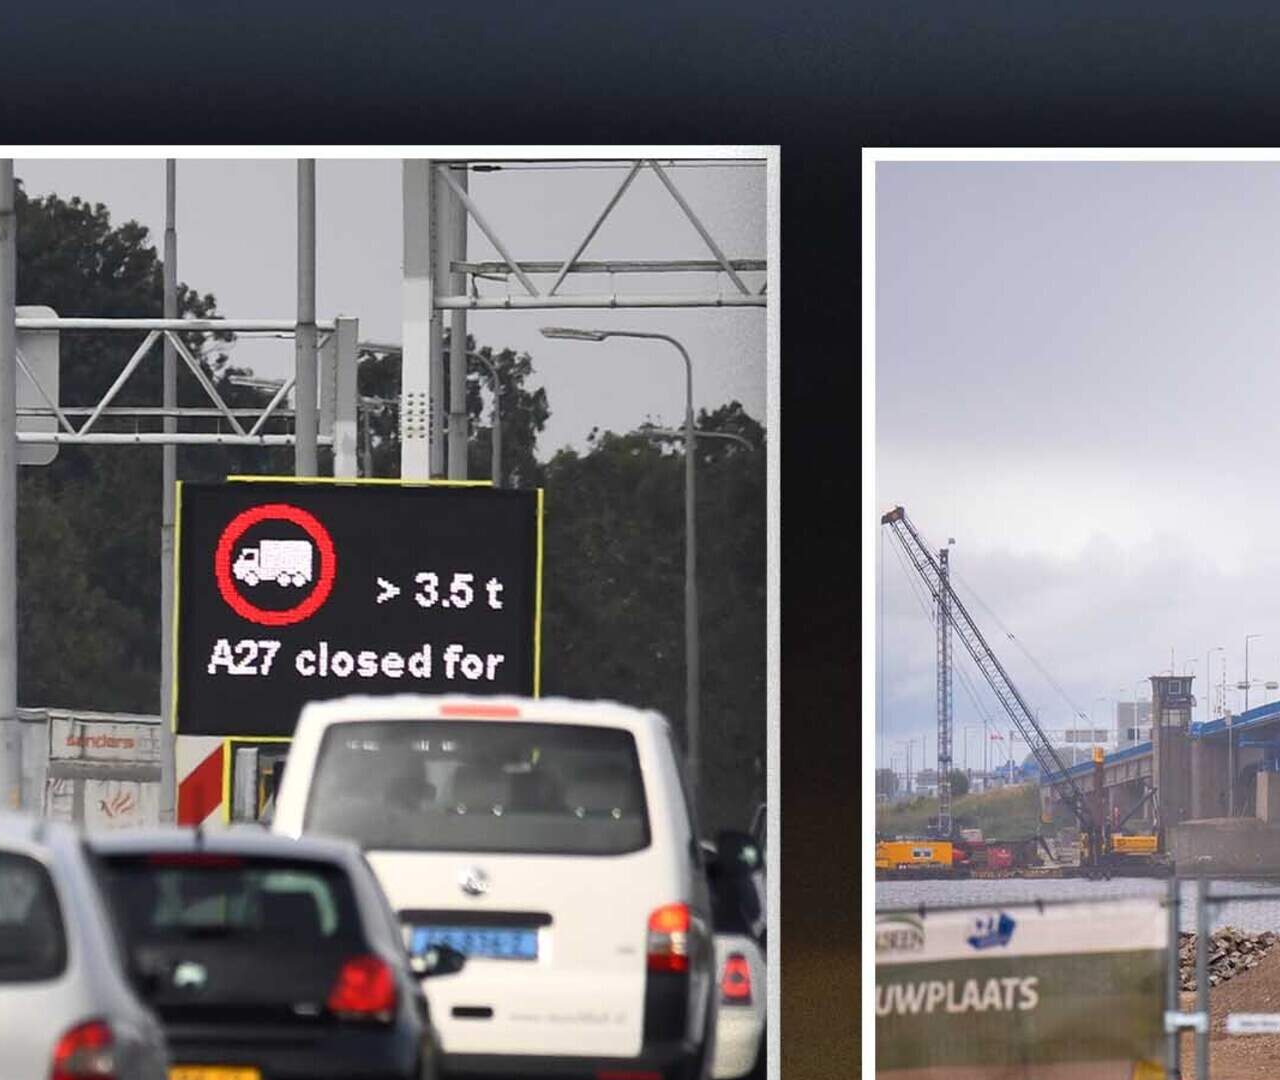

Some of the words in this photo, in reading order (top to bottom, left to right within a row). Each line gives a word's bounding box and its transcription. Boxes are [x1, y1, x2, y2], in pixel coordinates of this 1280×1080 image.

[414, 572, 474, 609] 3.5
[486, 577, 504, 609] t
[207, 638, 281, 676] A27
[295, 641, 433, 679] closed
[443, 644, 505, 680] for
